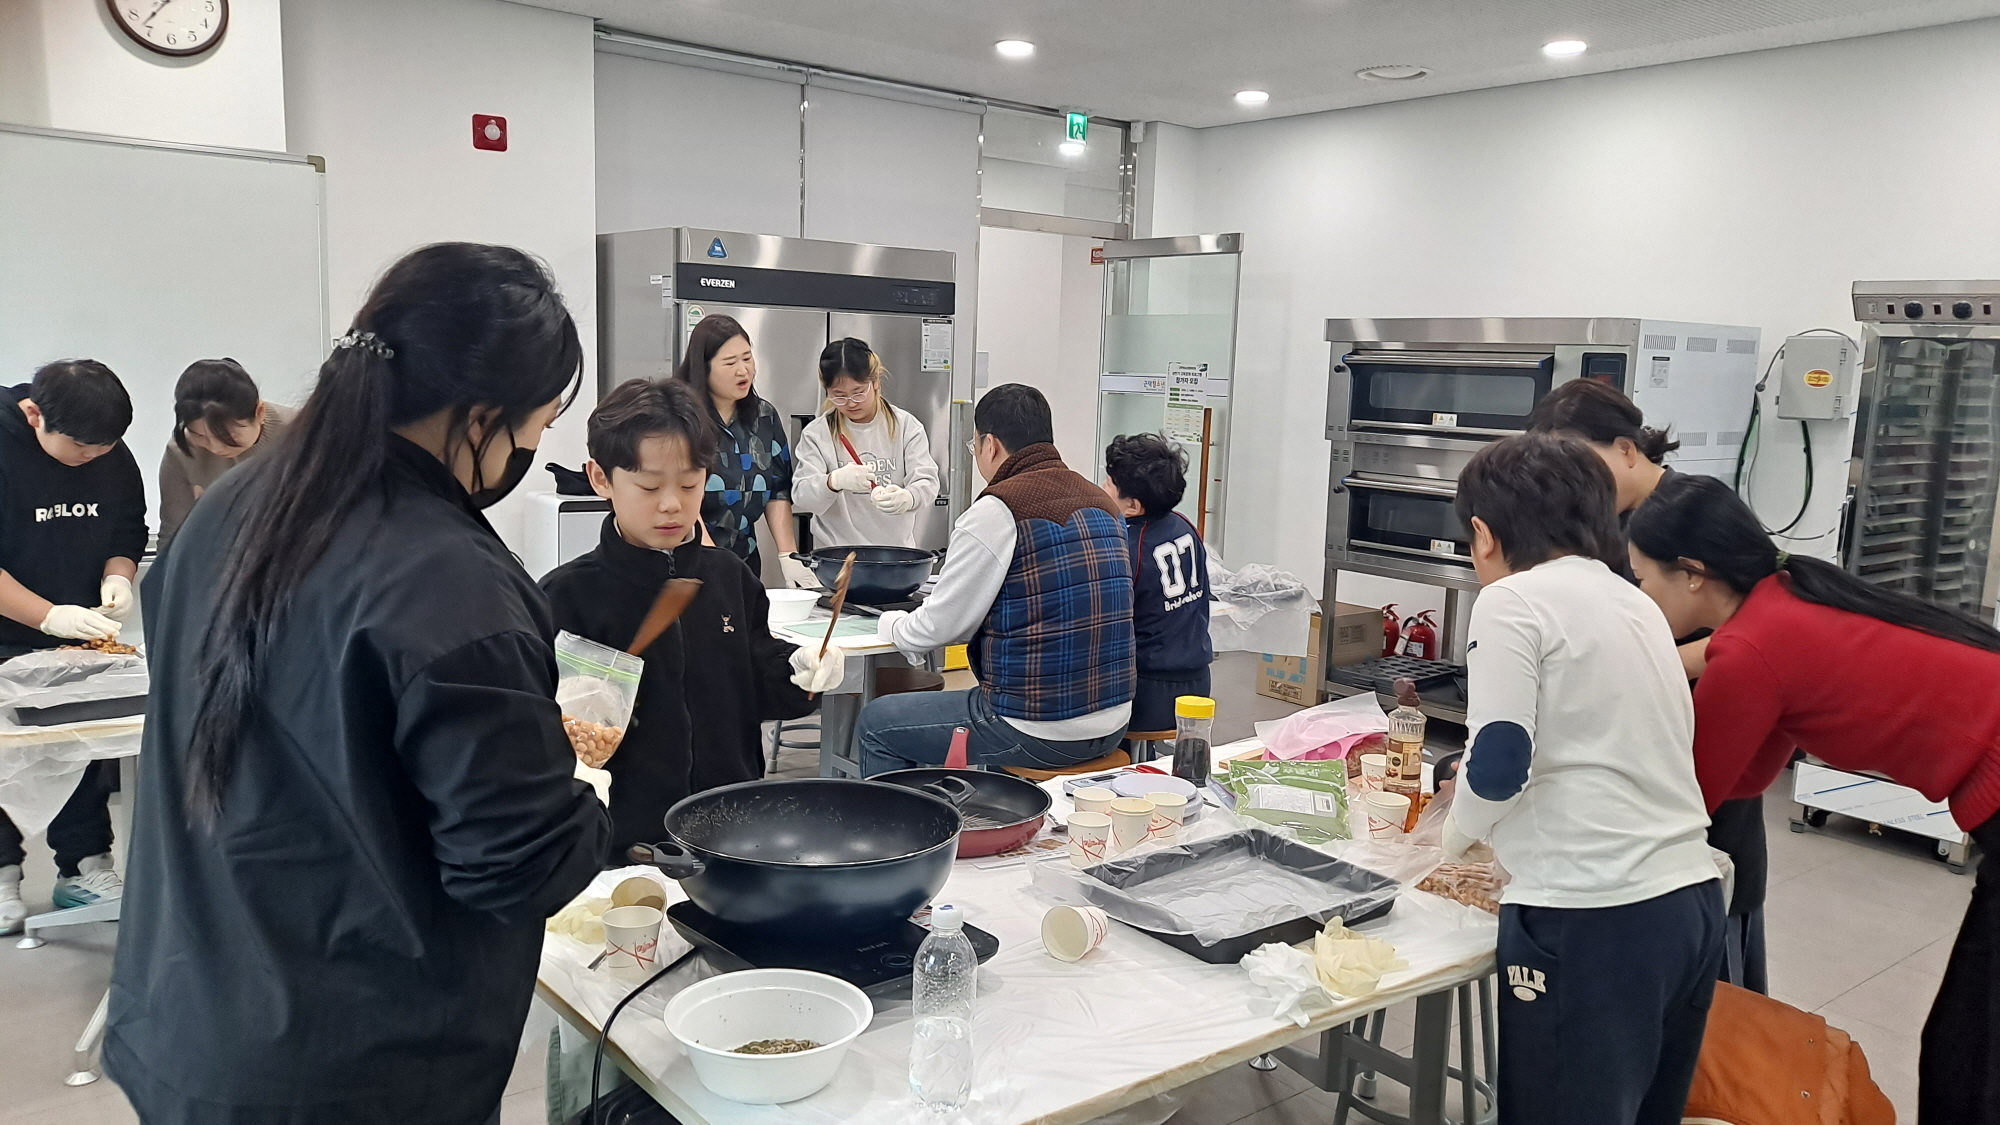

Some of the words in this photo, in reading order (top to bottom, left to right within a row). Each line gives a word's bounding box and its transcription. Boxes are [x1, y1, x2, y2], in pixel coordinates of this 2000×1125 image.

[128, 8, 140, 21] 8
[200, 18, 208, 29] 4
[145, 25, 153, 37] 7
[188, 30, 198, 42] 5
[166, 33, 177, 45] 6
[700, 277, 736, 288] EVERZEN
[1152, 533, 1199, 599] 07
